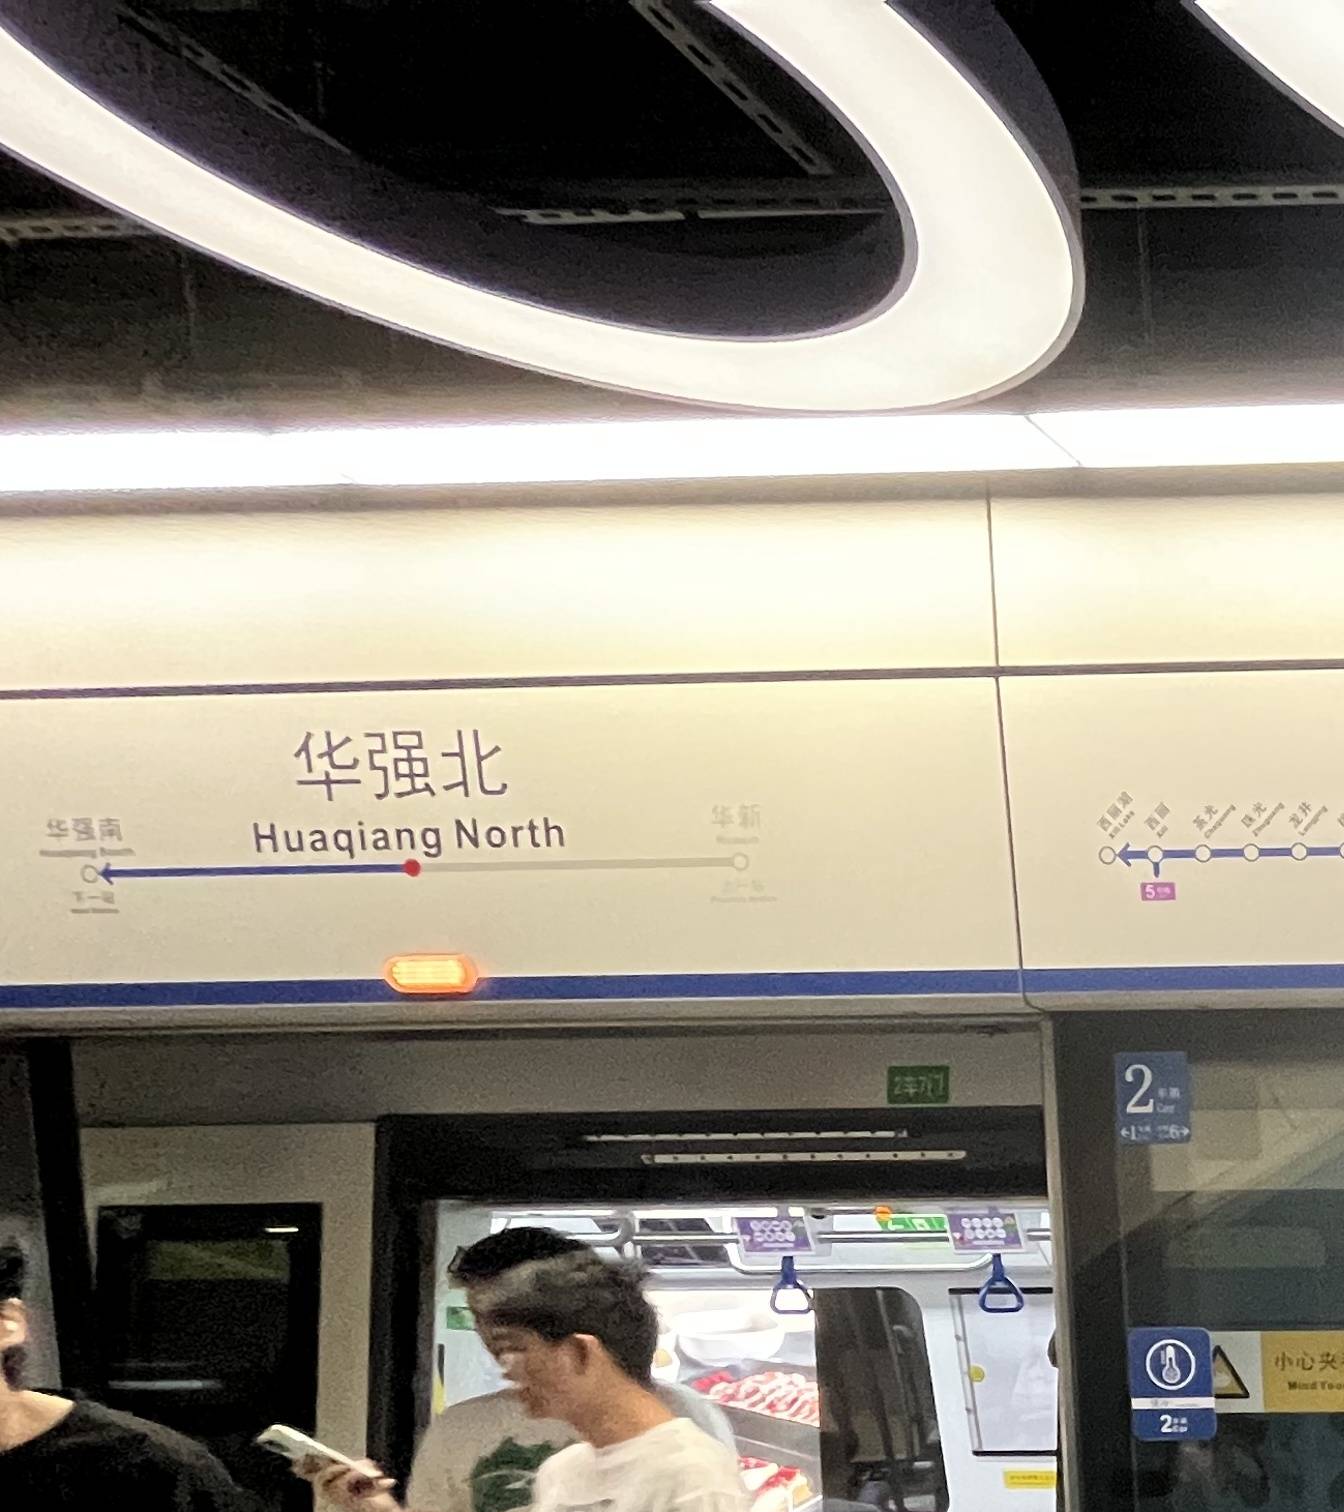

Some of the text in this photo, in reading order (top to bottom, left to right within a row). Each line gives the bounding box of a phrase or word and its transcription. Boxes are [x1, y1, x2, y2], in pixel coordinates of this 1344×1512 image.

[294, 729, 508, 800] 华强北
[253, 817, 566, 858] Huaqiang North
[1125, 1064, 1154, 1113] 2
[1160, 1414, 1173, 1433] 2
